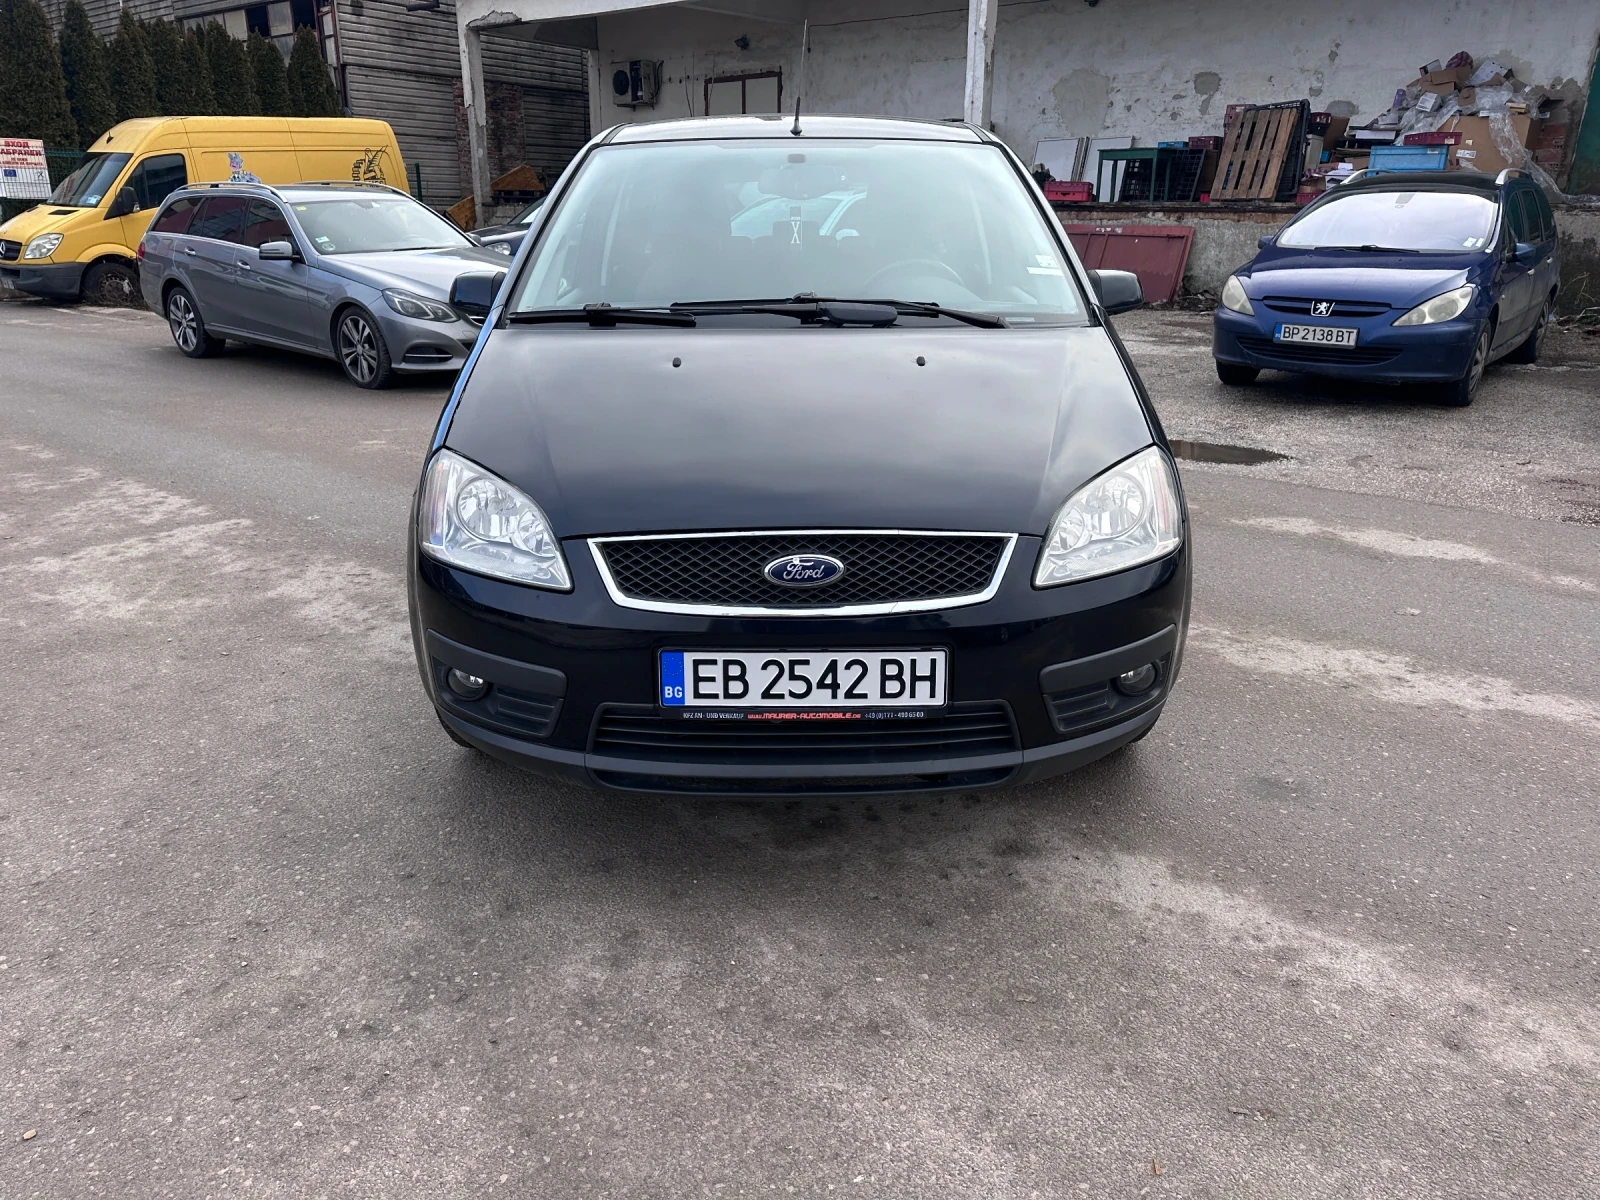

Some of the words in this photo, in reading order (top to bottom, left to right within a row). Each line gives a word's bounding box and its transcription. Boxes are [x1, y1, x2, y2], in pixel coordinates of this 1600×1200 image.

[4, 141, 29, 149] ВХОД
[1283, 326, 1300, 339] BP
[1301, 328, 1333, 342] 2138
[1335, 330, 1354, 344] BT
[783, 559, 825, 580] Ford
[664, 686, 683, 699] BG
[692, 658, 750, 700] EB
[760, 658, 869, 700] 2542
[879, 657, 937, 700] BH
